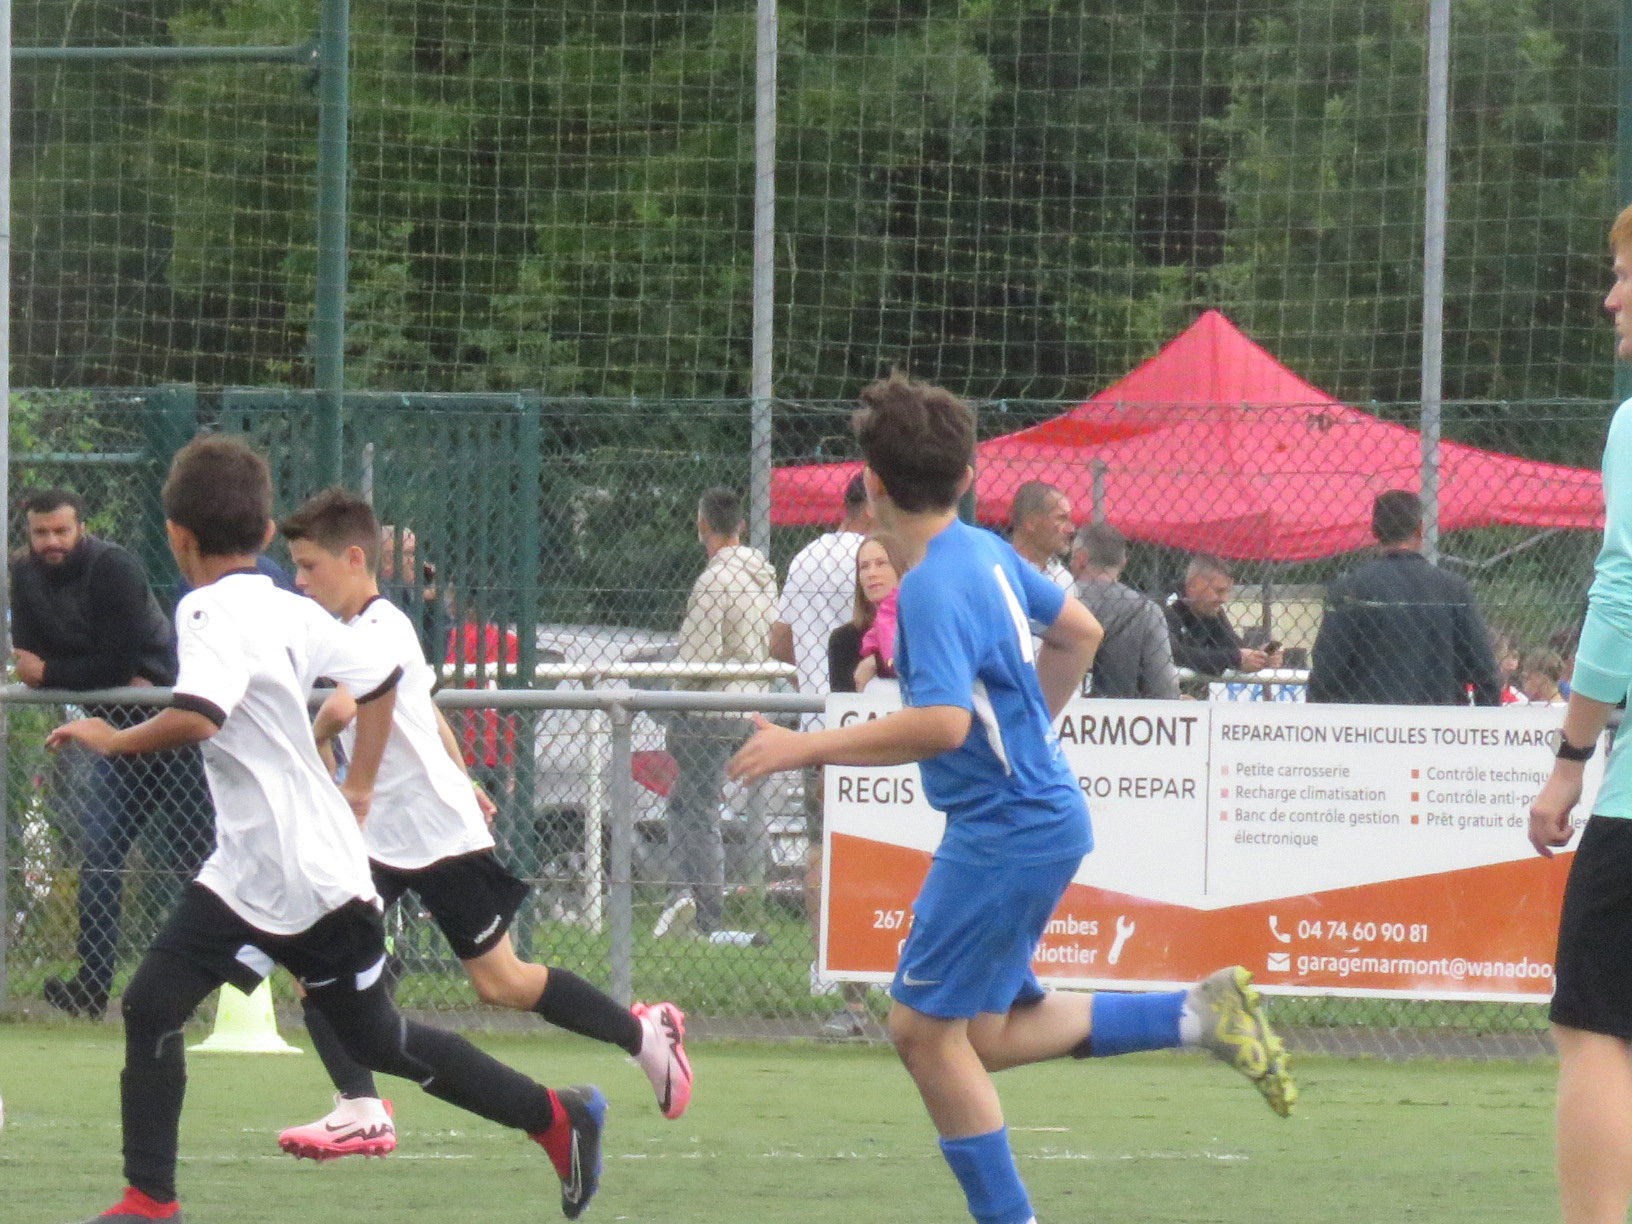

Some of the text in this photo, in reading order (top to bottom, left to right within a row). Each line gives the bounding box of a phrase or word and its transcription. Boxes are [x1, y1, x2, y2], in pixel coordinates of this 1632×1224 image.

[1058, 713, 1198, 747] ARMONT
[1221, 724, 1555, 747] REPARATION VEHICULES TOUTES MAR
[1236, 762, 1350, 778] Petite carrosserie
[1426, 766, 1549, 785] Contrôle techniqu
[838, 776, 1196, 804] REGIS RO REPAR
[1236, 785, 1386, 803] Recharge climatisation
[1426, 789, 1536, 808] Contrôle anti-p
[1234, 808, 1400, 827] Banc de contrôle gestion
[1426, 812, 1454, 827] Prêt
[1458, 813, 1503, 830] gratuit
[1506, 813, 1523, 828] de
[1234, 830, 1318, 847] électronique
[872, 909, 905, 929] 267
[1044, 913, 1099, 936] mbes
[1298, 919, 1429, 942] 04 74 60 90 81
[1297, 955, 1554, 980] garagemarmont@wanadoo
